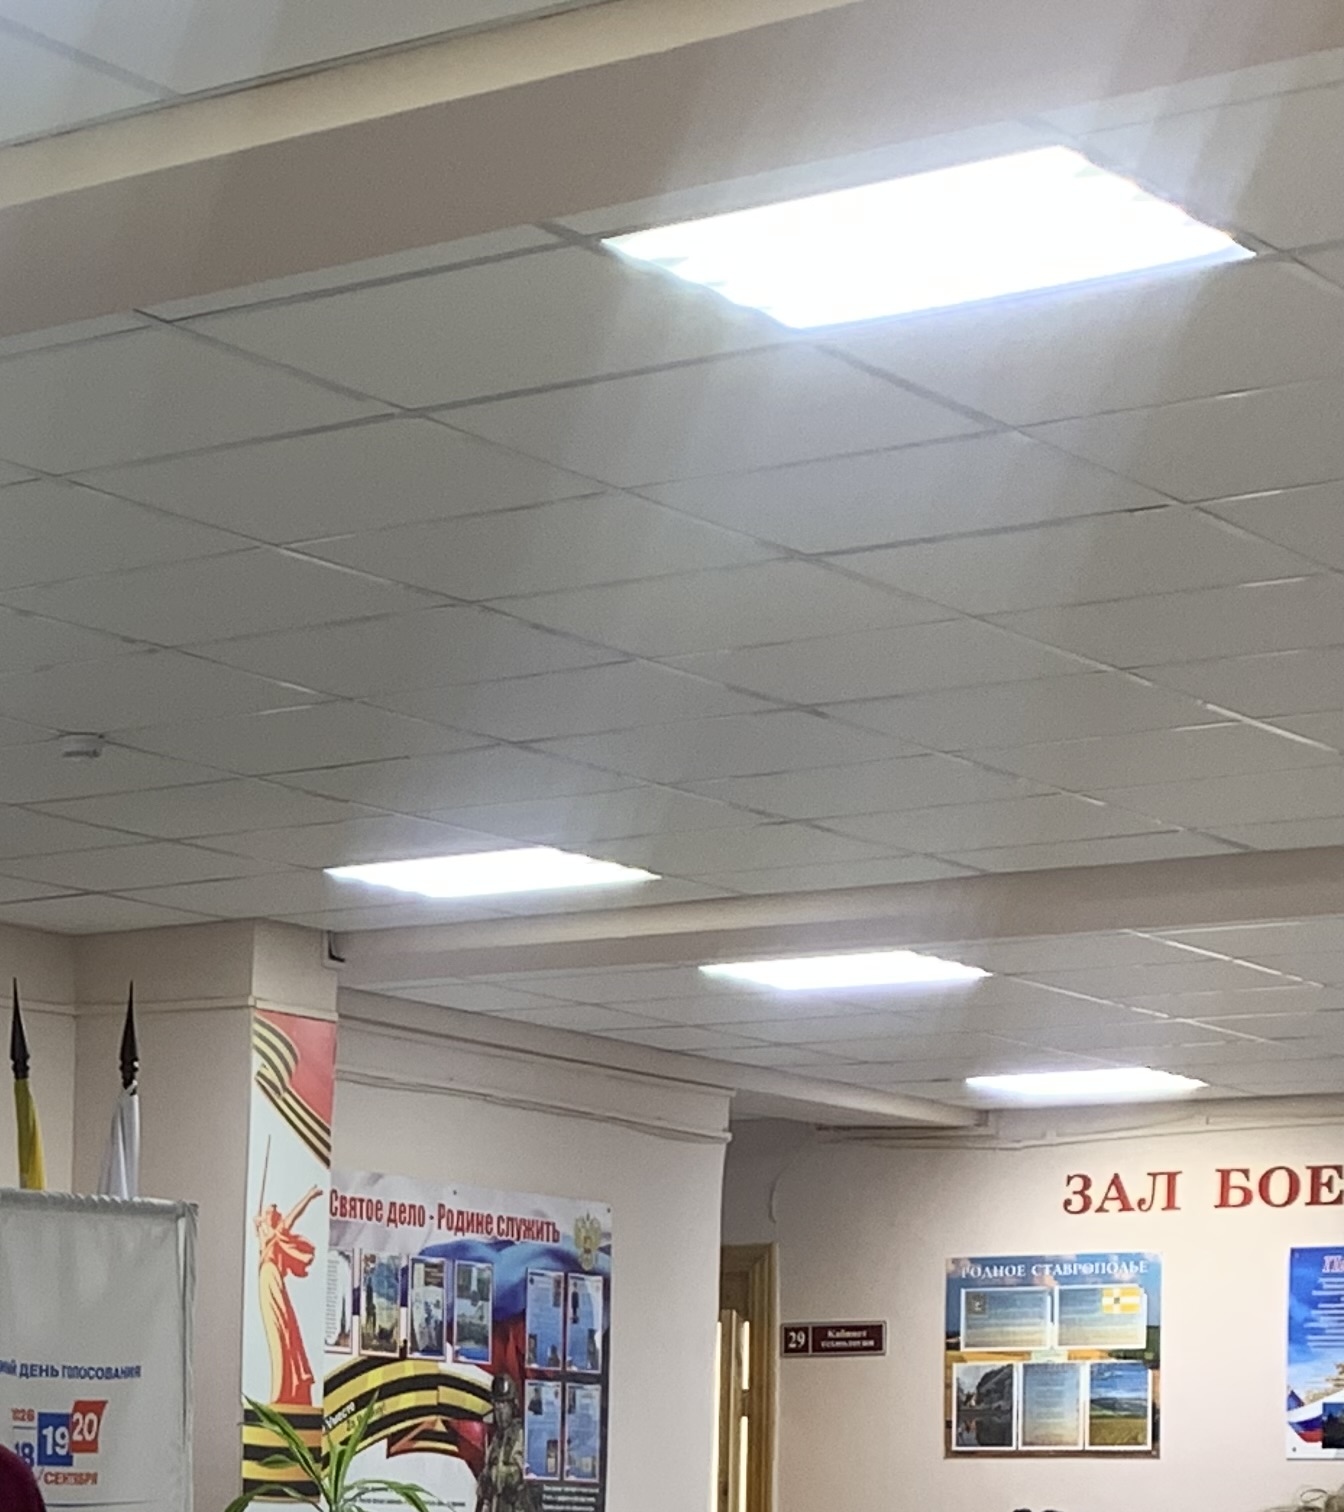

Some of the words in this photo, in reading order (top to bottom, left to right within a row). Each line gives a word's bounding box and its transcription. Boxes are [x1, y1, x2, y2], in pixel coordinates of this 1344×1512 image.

[1062, 1171, 1183, 1215] ЗАЛ
[1213, 1164, 1344, 1209] БОЕ
[329, 1188, 384, 1222] Святое
[387, 1202, 425, 1228] дело
[437, 1203, 494, 1236] Родине
[496, 1215, 561, 1244] служить
[962, 1264, 1027, 1279] РОДНОЕ
[1031, 1260, 1149, 1277] СТАВРОПОЛЬЕ
[788, 1331, 806, 1348] 29
[19, 1363, 59, 1379] ДЕНЬ
[42, 1425, 70, 1455] 19
[73, 1411, 98, 1441] 20
